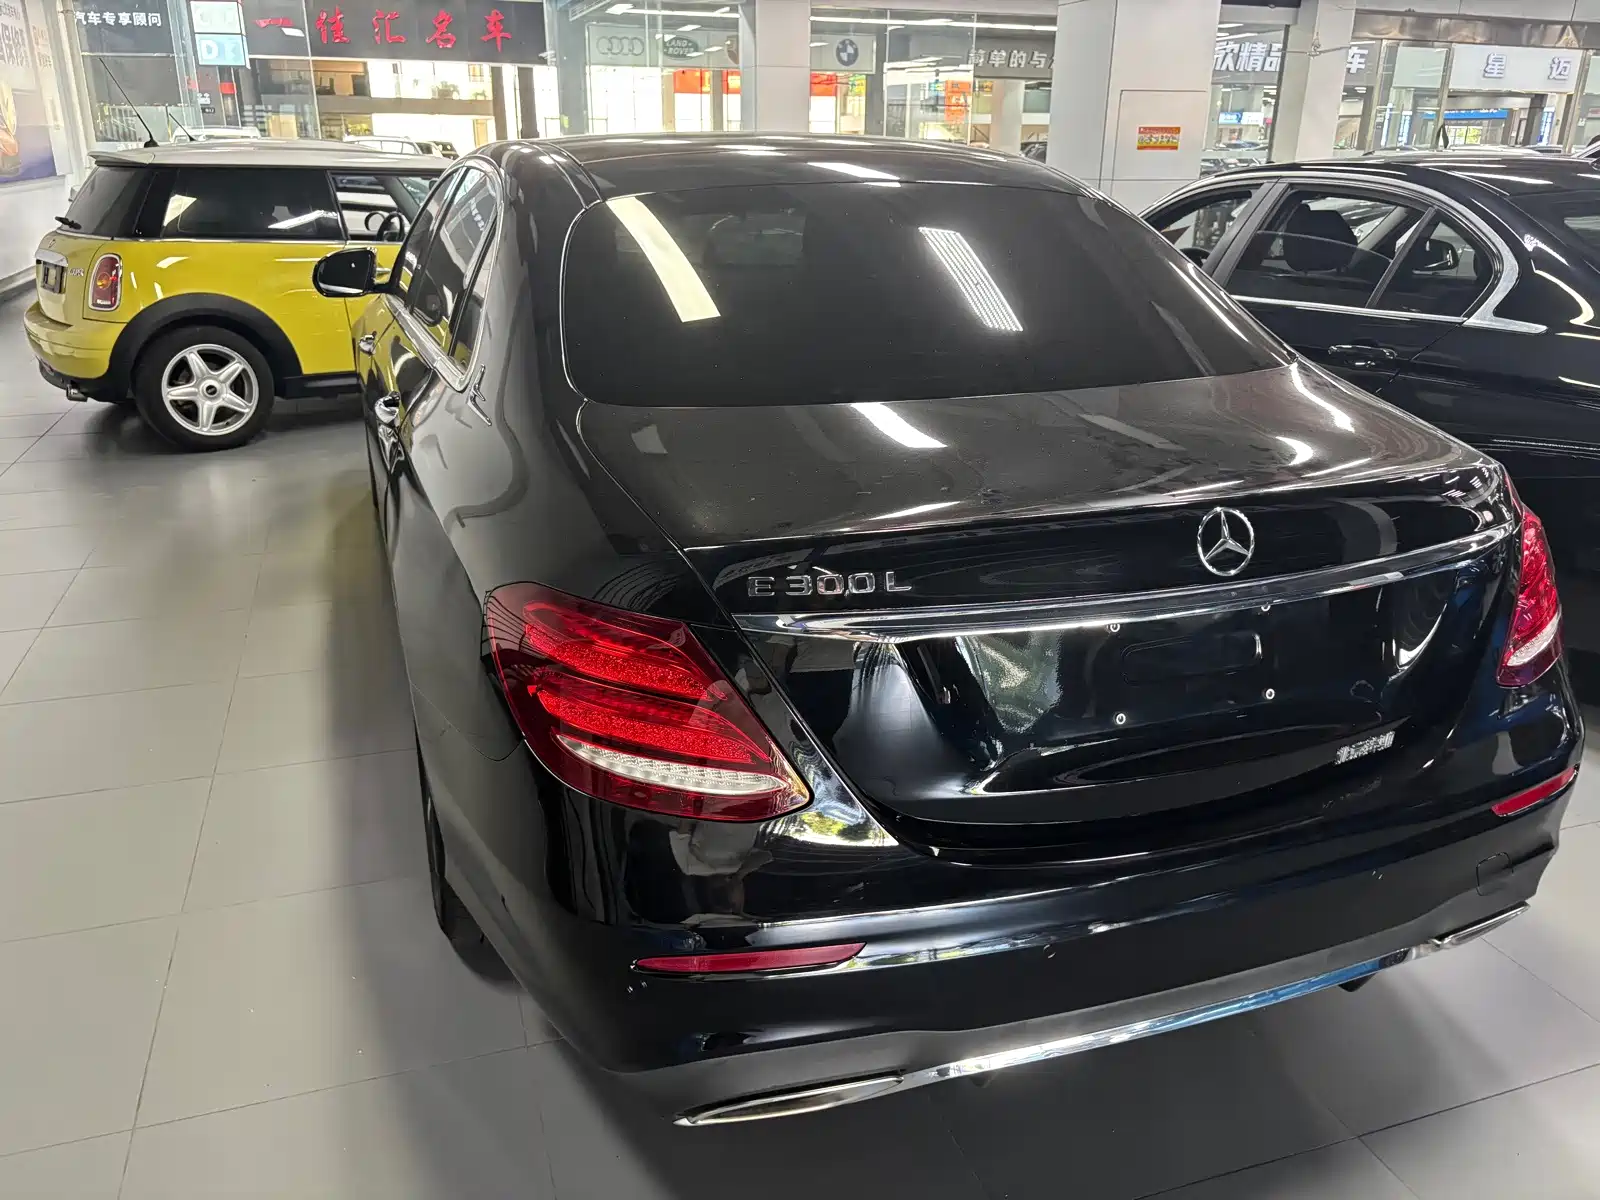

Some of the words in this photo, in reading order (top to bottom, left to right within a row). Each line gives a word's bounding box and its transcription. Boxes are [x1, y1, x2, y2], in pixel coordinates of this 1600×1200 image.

[75, 11, 162, 27] 汽车专享顾问
[968, 49, 1055, 68] 简单的与
